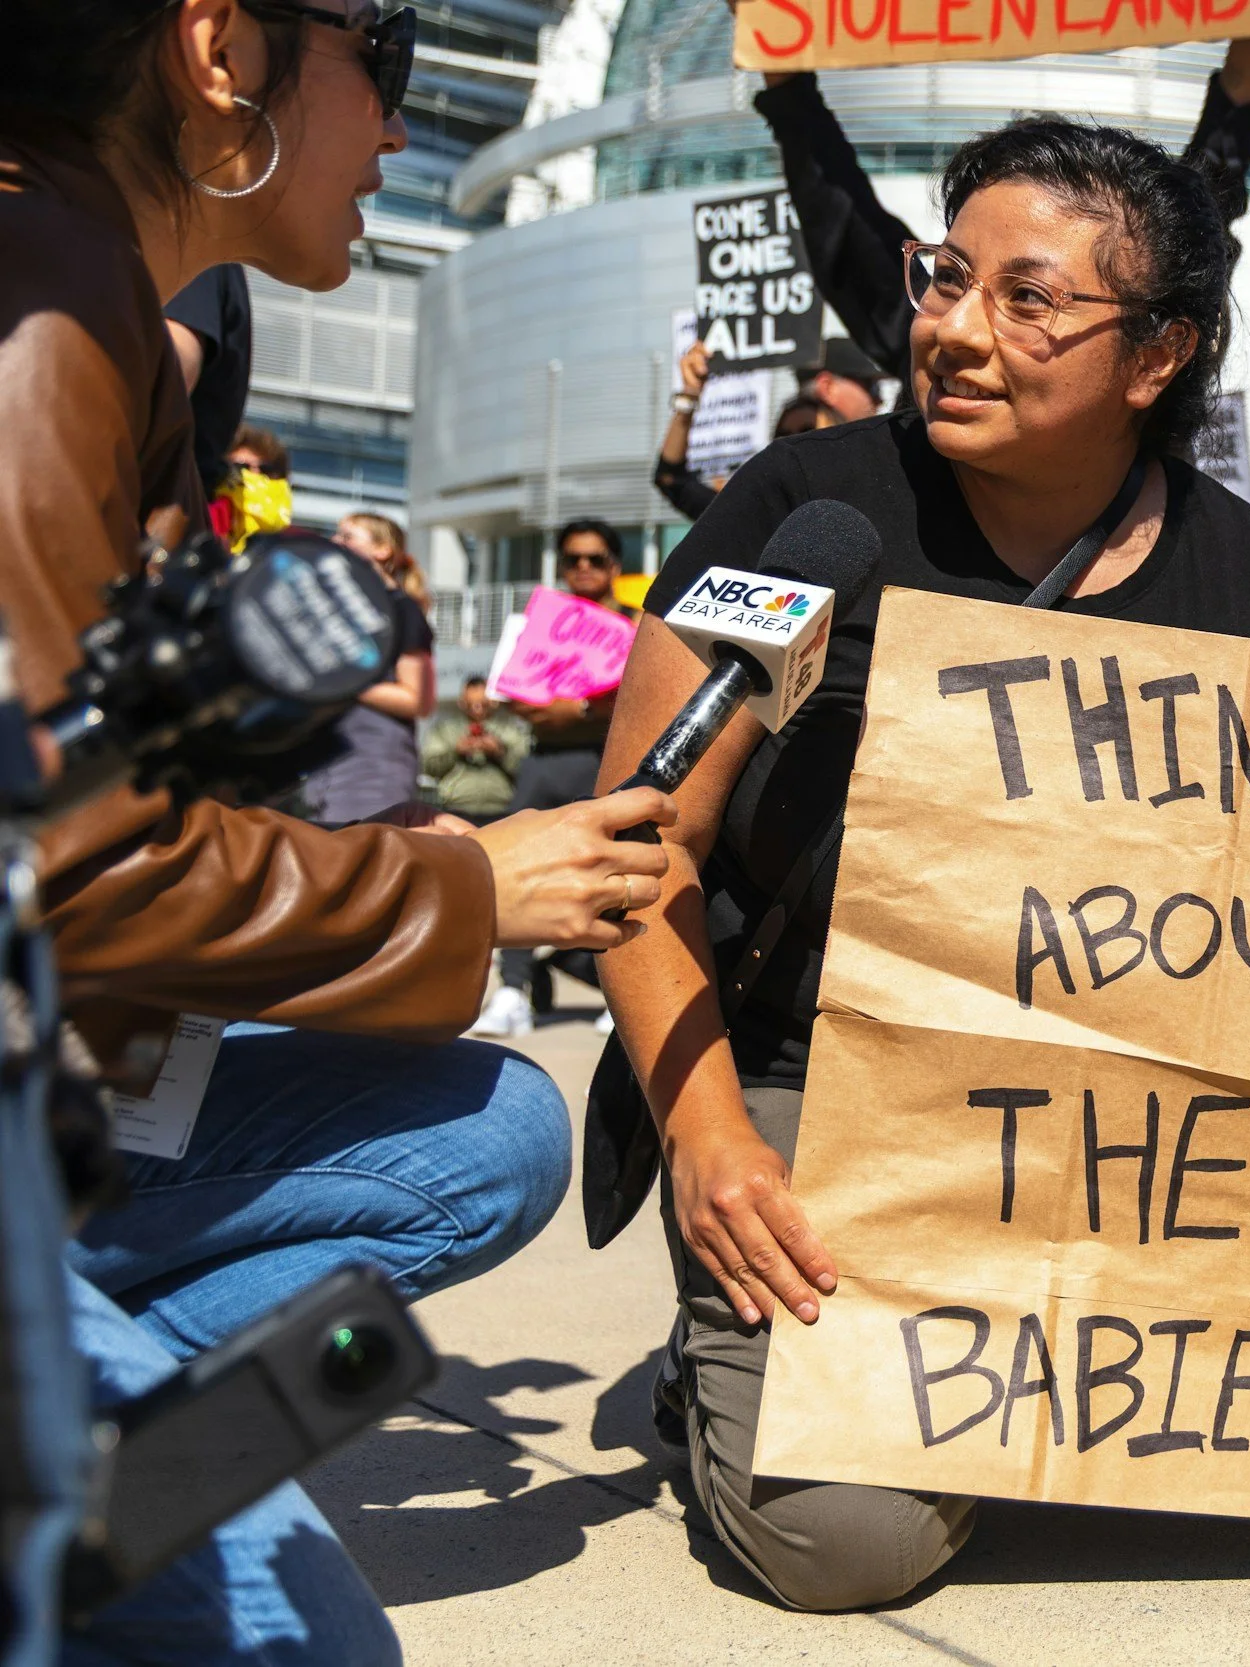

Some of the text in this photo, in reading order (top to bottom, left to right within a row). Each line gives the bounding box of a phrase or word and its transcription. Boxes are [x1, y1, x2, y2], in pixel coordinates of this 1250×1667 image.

[696, 199, 770, 242] COME
[708, 236, 796, 279] ONE
[763, 272, 815, 315] US
[703, 315, 796, 360] ALL
[693, 576, 773, 608] NBC
[679, 601, 793, 633] BAY AREA
[794, 661, 813, 698] 48
